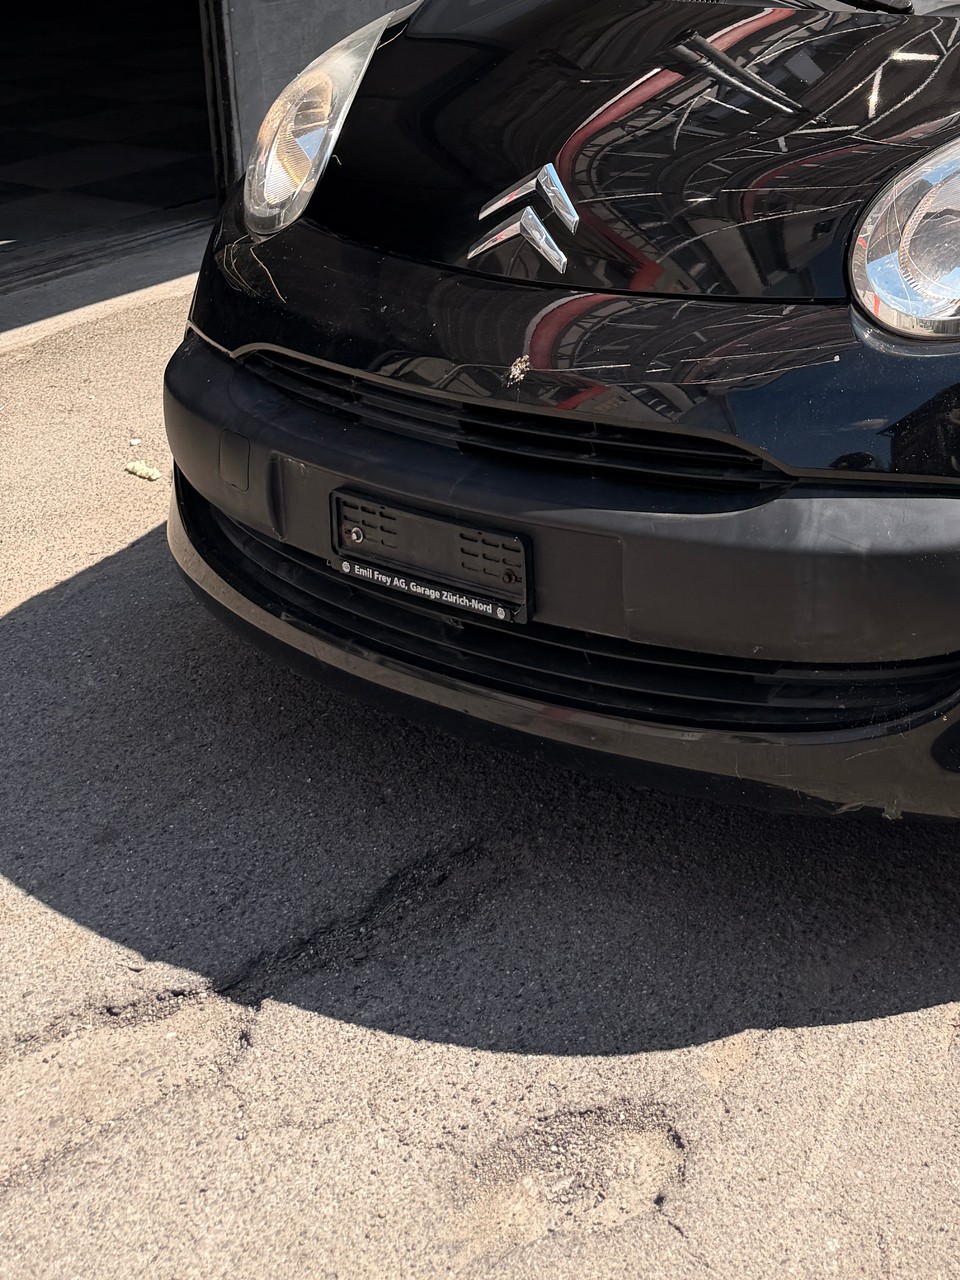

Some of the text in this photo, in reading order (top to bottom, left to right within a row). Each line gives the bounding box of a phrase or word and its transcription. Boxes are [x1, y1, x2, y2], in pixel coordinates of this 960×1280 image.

[354, 565, 492, 614] Emil Frey AG, Garage Zürich-Nord
